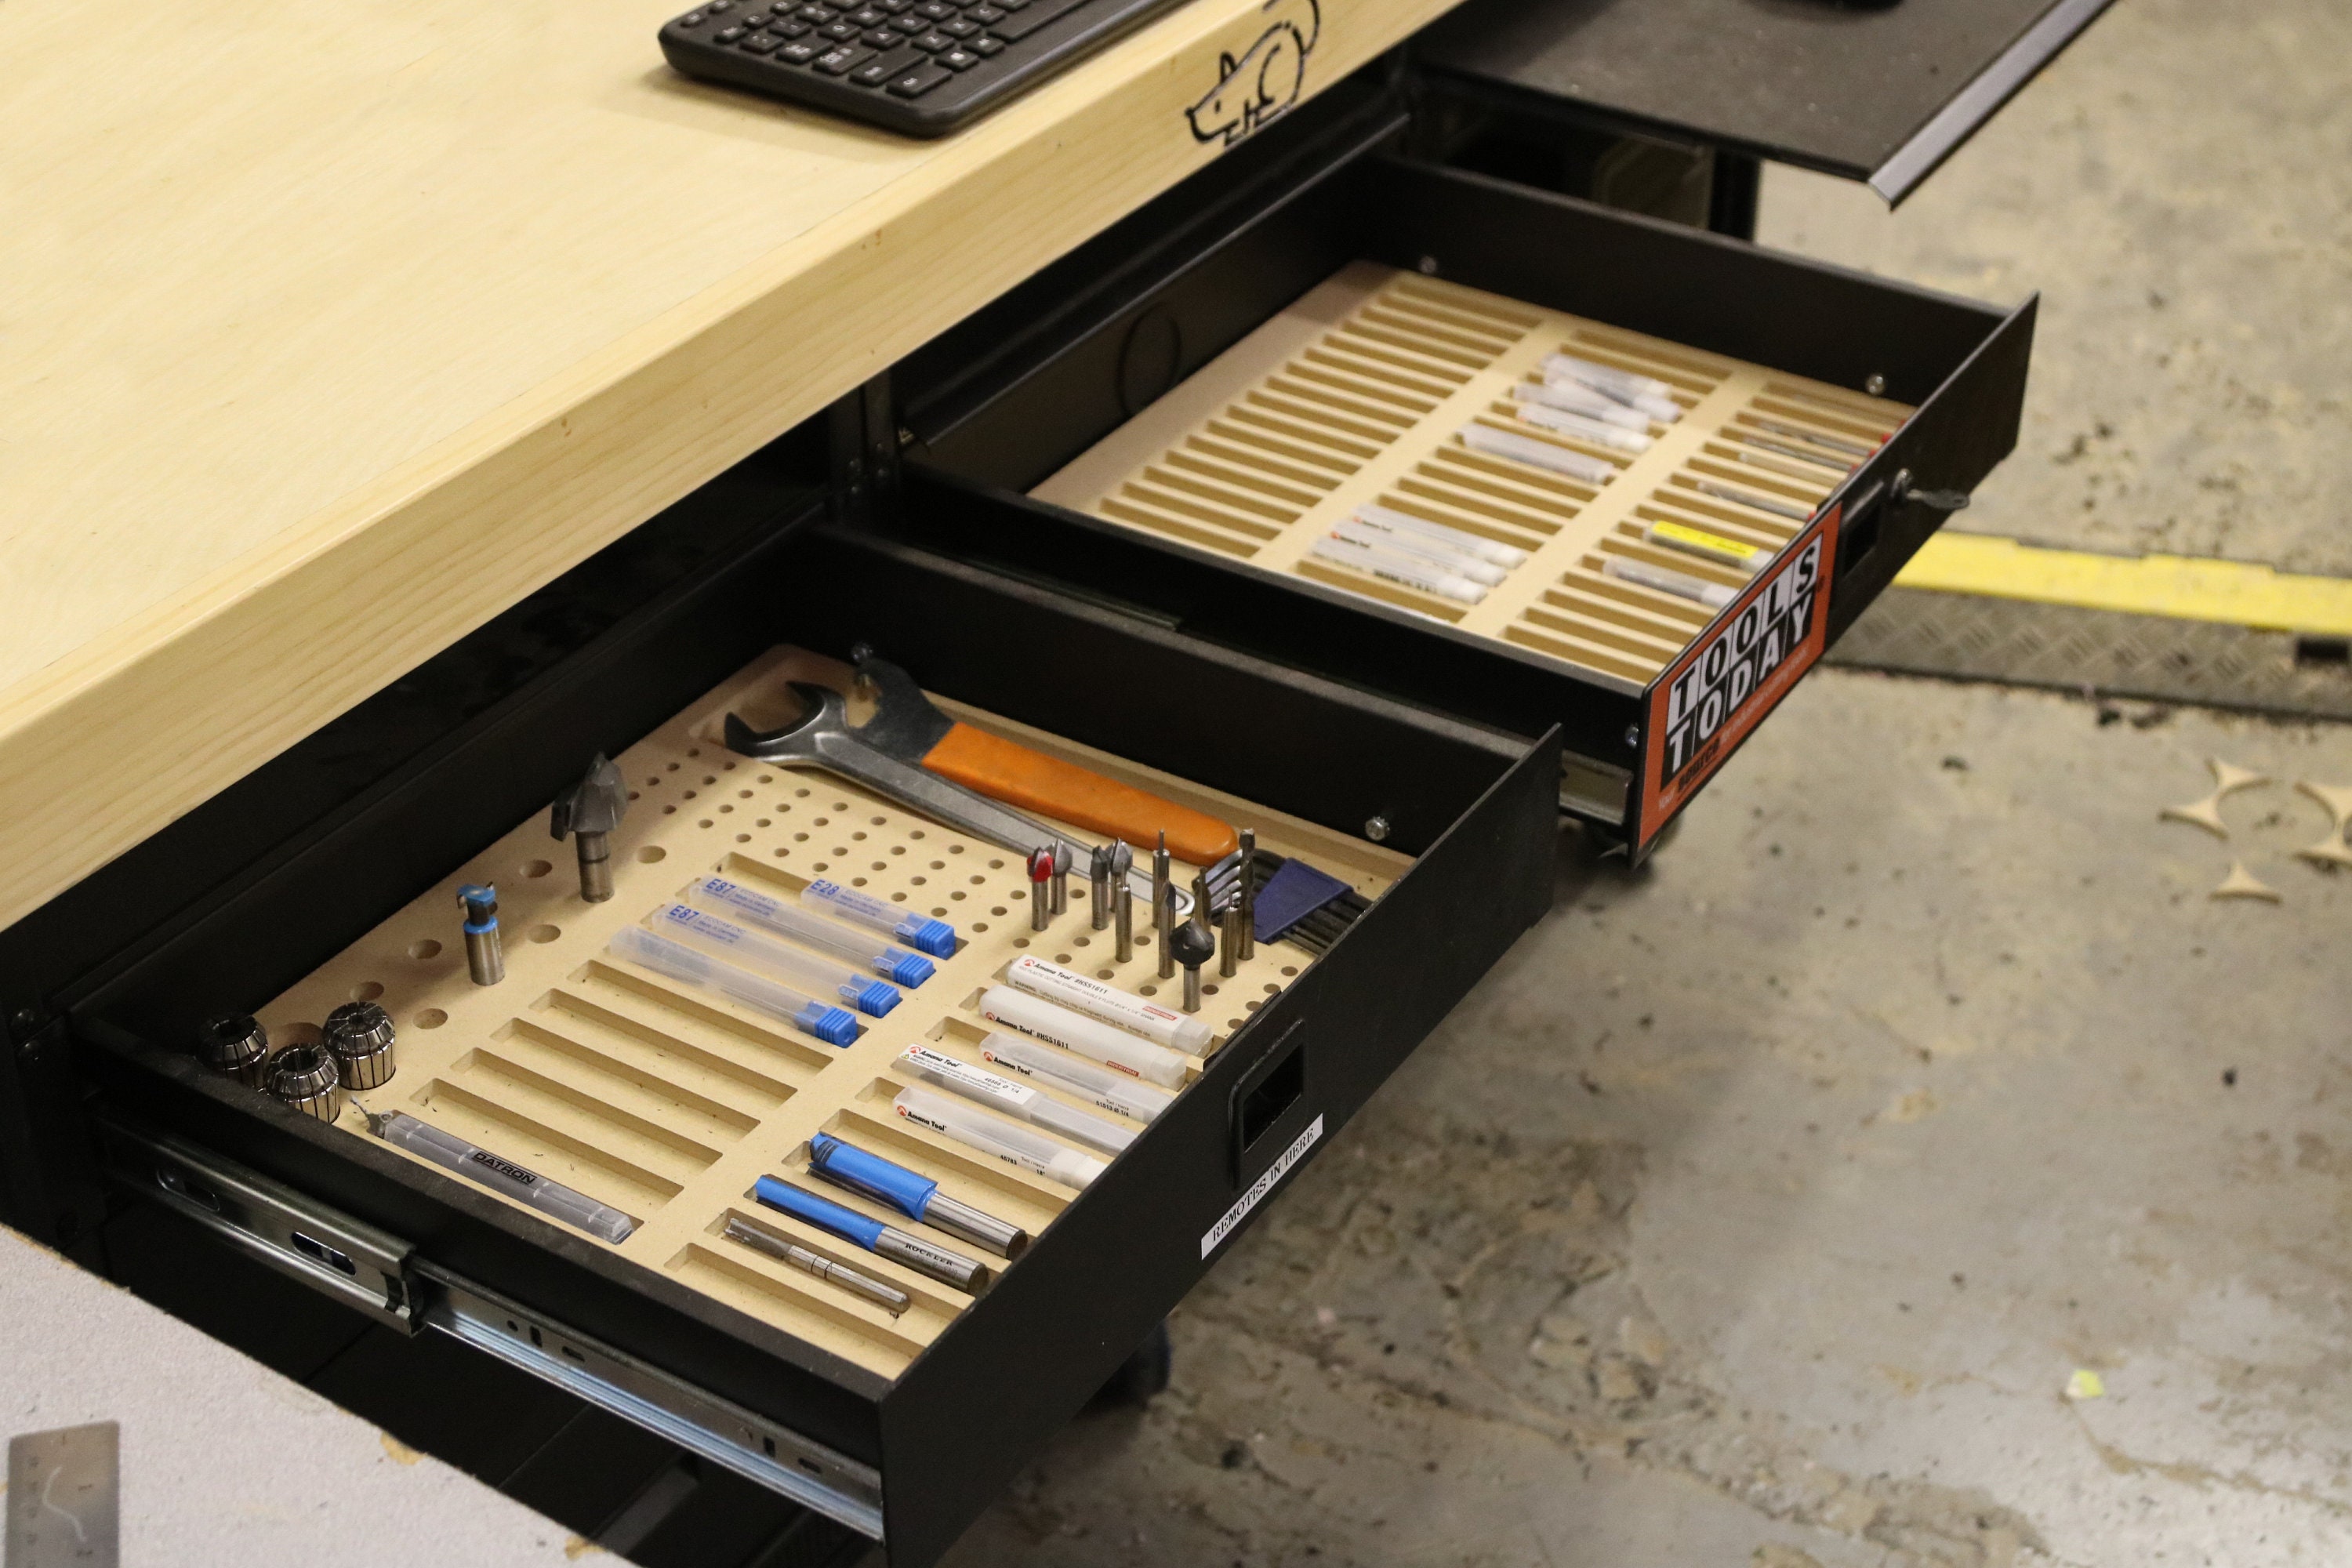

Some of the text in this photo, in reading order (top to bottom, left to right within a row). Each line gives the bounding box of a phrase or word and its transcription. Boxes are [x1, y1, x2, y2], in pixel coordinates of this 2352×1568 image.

[1675, 543, 1817, 720] TOOLS
[1669, 593, 1813, 774] TODAY
[706, 878, 736, 894] E87
[810, 879, 840, 895] E28
[669, 905, 699, 920] E87
[1034, 964, 1056, 975] Amana
[1058, 972, 1073, 981] Tool
[996, 1017, 1069, 1049] Amana Tool #HSS1611
[920, 1051, 959, 1068] Amana Tool
[994, 1057, 1030, 1076] Amana Tool
[908, 1111, 945, 1131] Amana Tool
[473, 1152, 535, 1184] DATRON
[1213, 1127, 1314, 1242] REMOTES IN HERE
[905, 1243, 953, 1266] ROCKLER
